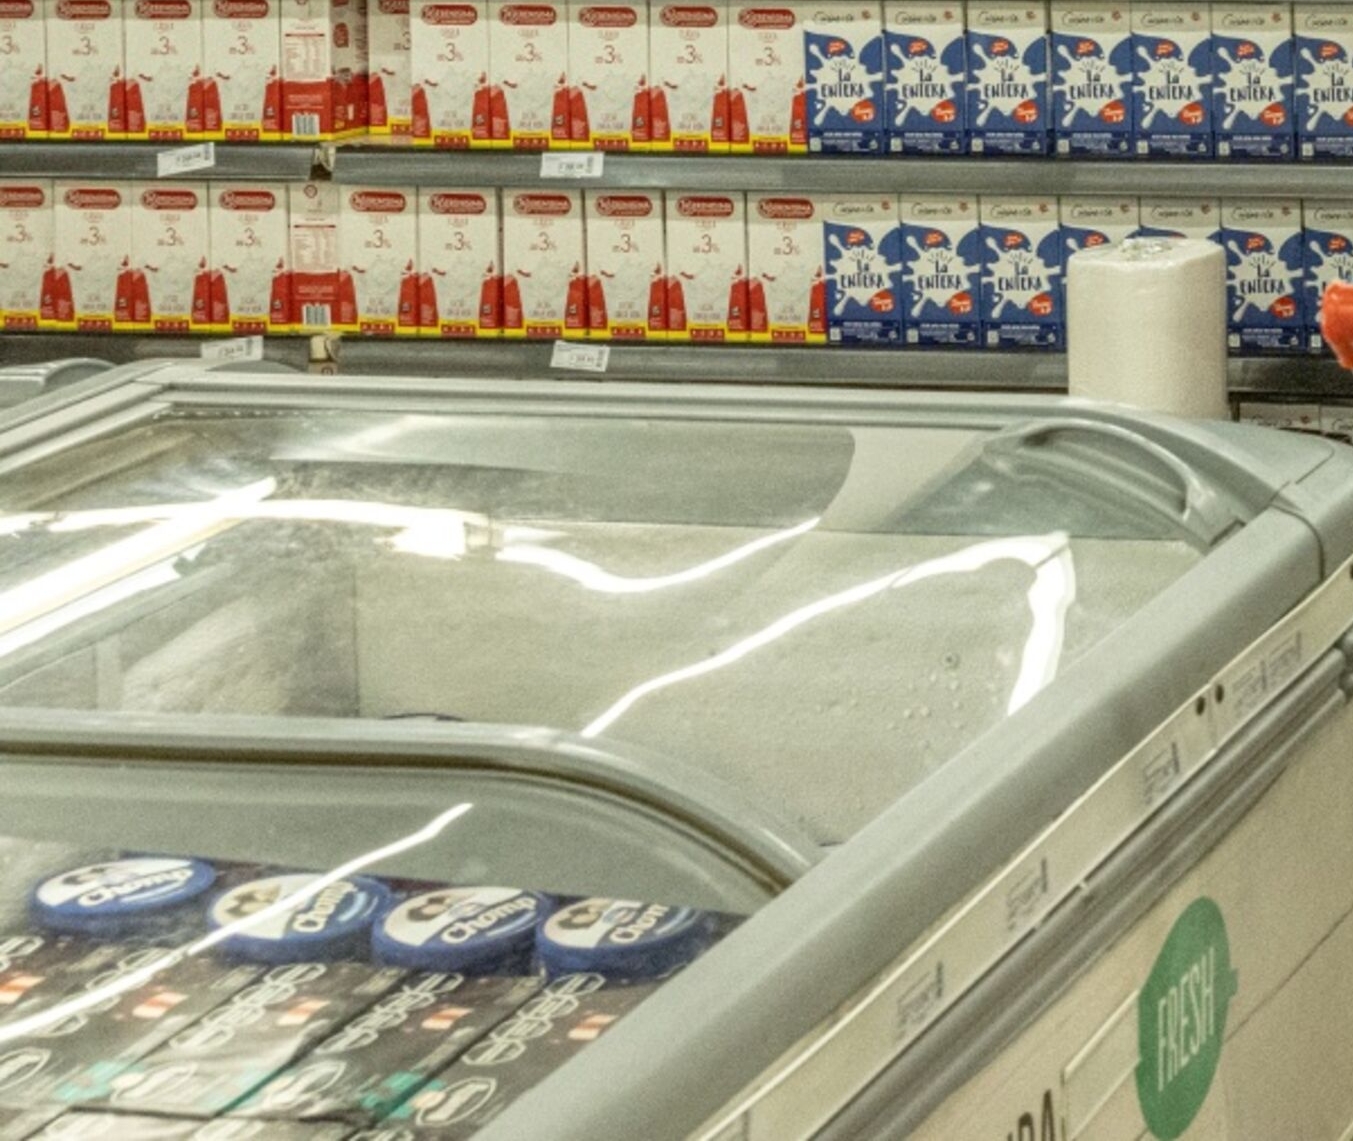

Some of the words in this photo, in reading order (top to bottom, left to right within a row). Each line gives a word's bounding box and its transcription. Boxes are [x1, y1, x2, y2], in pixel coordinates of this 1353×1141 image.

[77, 867, 195, 906] Chomp
[440, 895, 548, 945] Chomp
[609, 903, 671, 944] Chom
[1157, 946, 1216, 1092] FRESH
